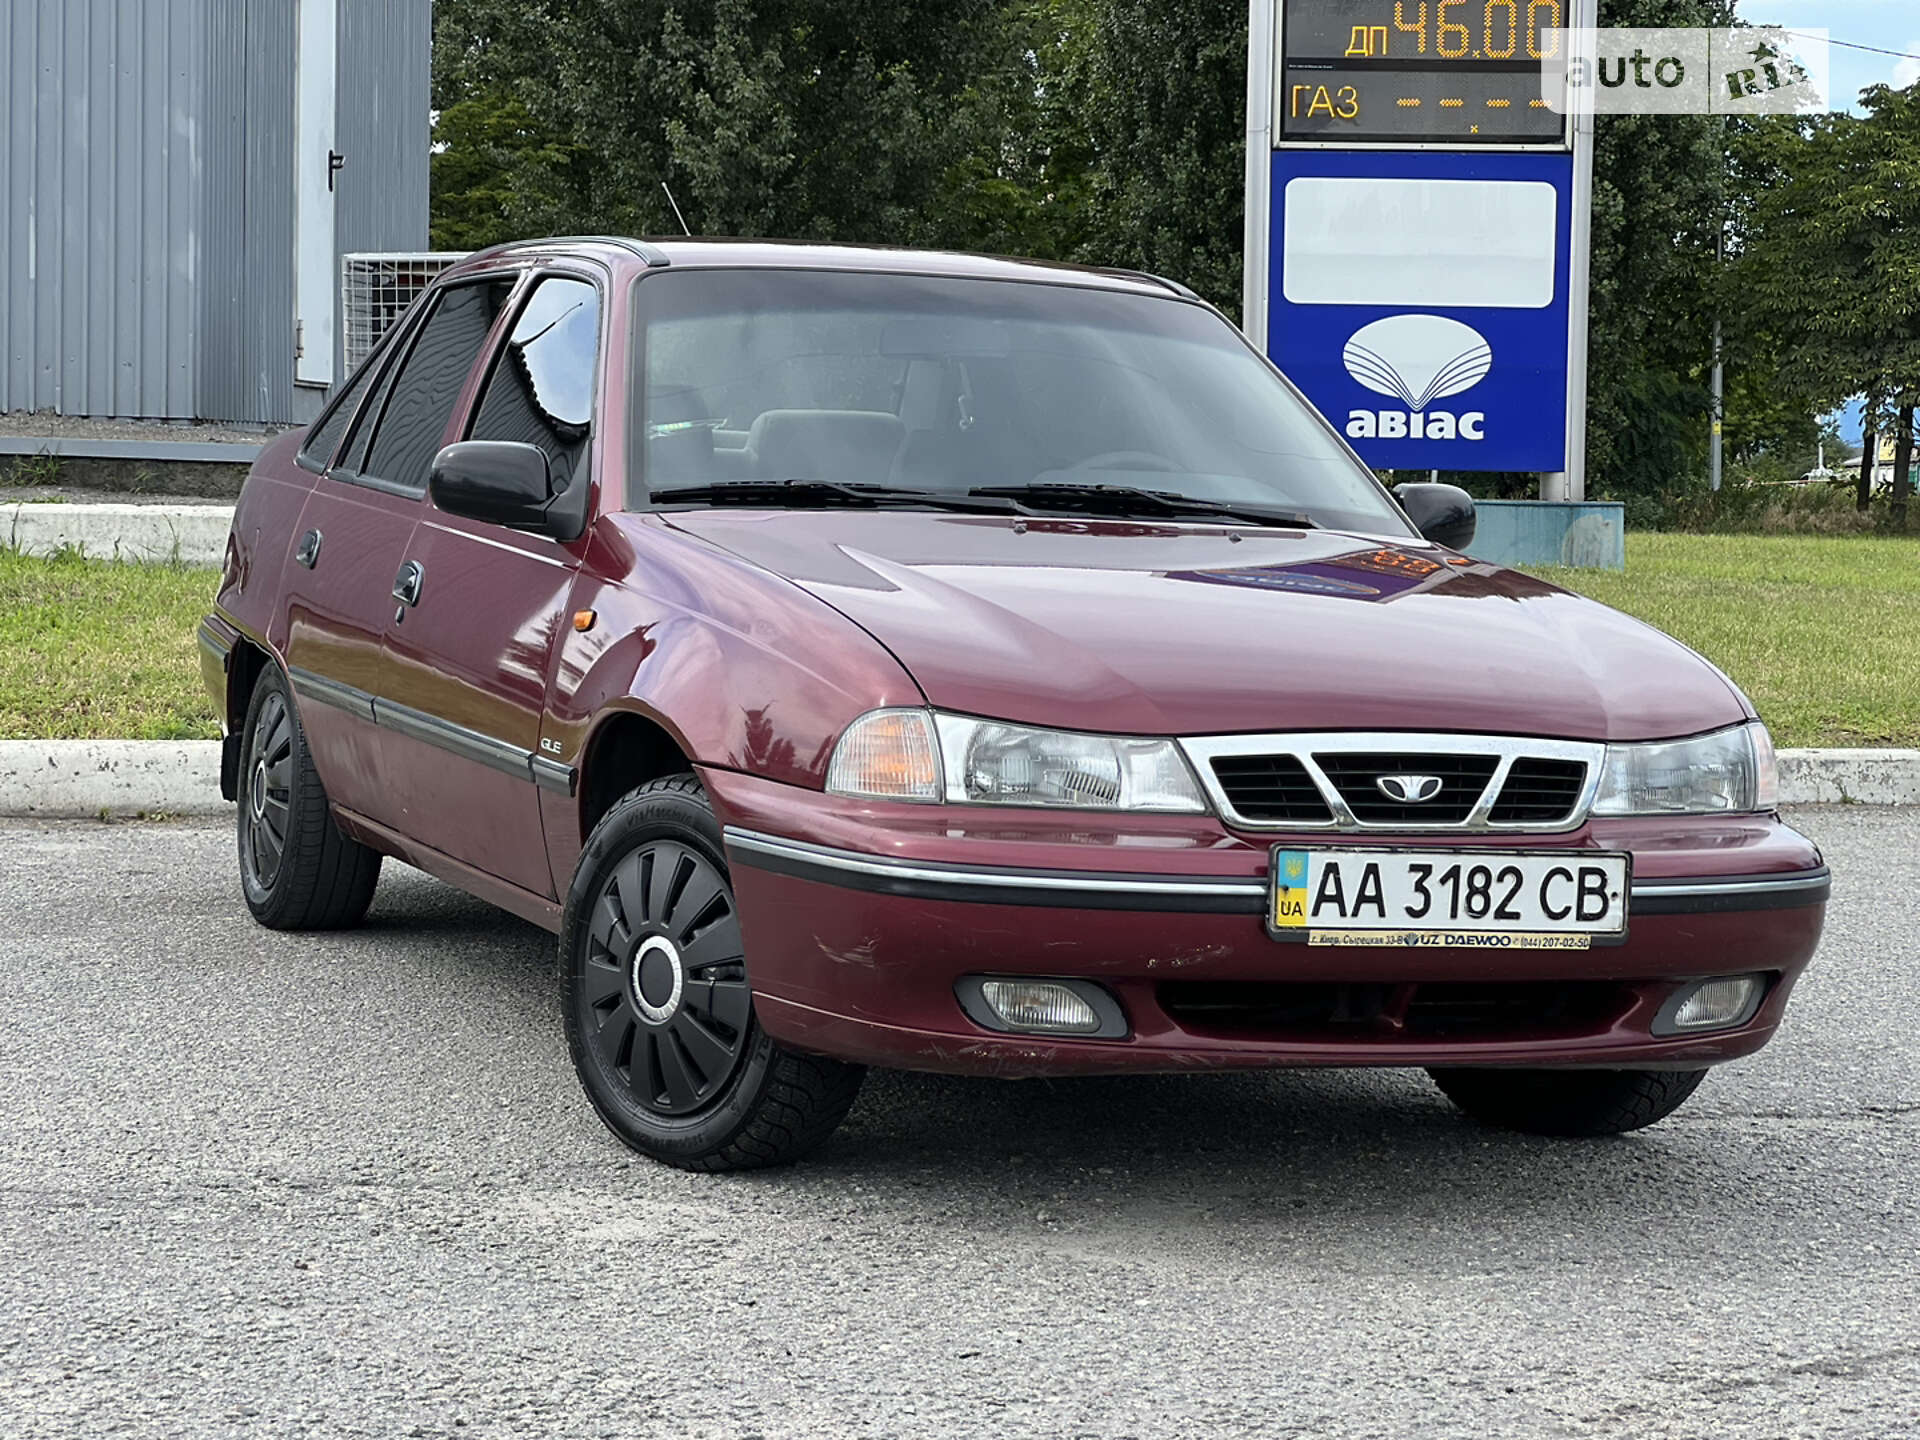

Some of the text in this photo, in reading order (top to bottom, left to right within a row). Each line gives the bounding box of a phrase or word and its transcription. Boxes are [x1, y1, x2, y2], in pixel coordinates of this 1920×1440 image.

[1344, 0, 1560, 58] ДП 46.00
[1291, 85, 1359, 118] ГАЗ
[540, 737, 562, 754] GLE
[1404, 864, 1524, 920] 3182
[1280, 901, 1304, 917] UA
[1421, 935, 1440, 945] UZ
[1445, 935, 1512, 946] DAEWOO
[1542, 937, 1589, 948] 207-02-50
